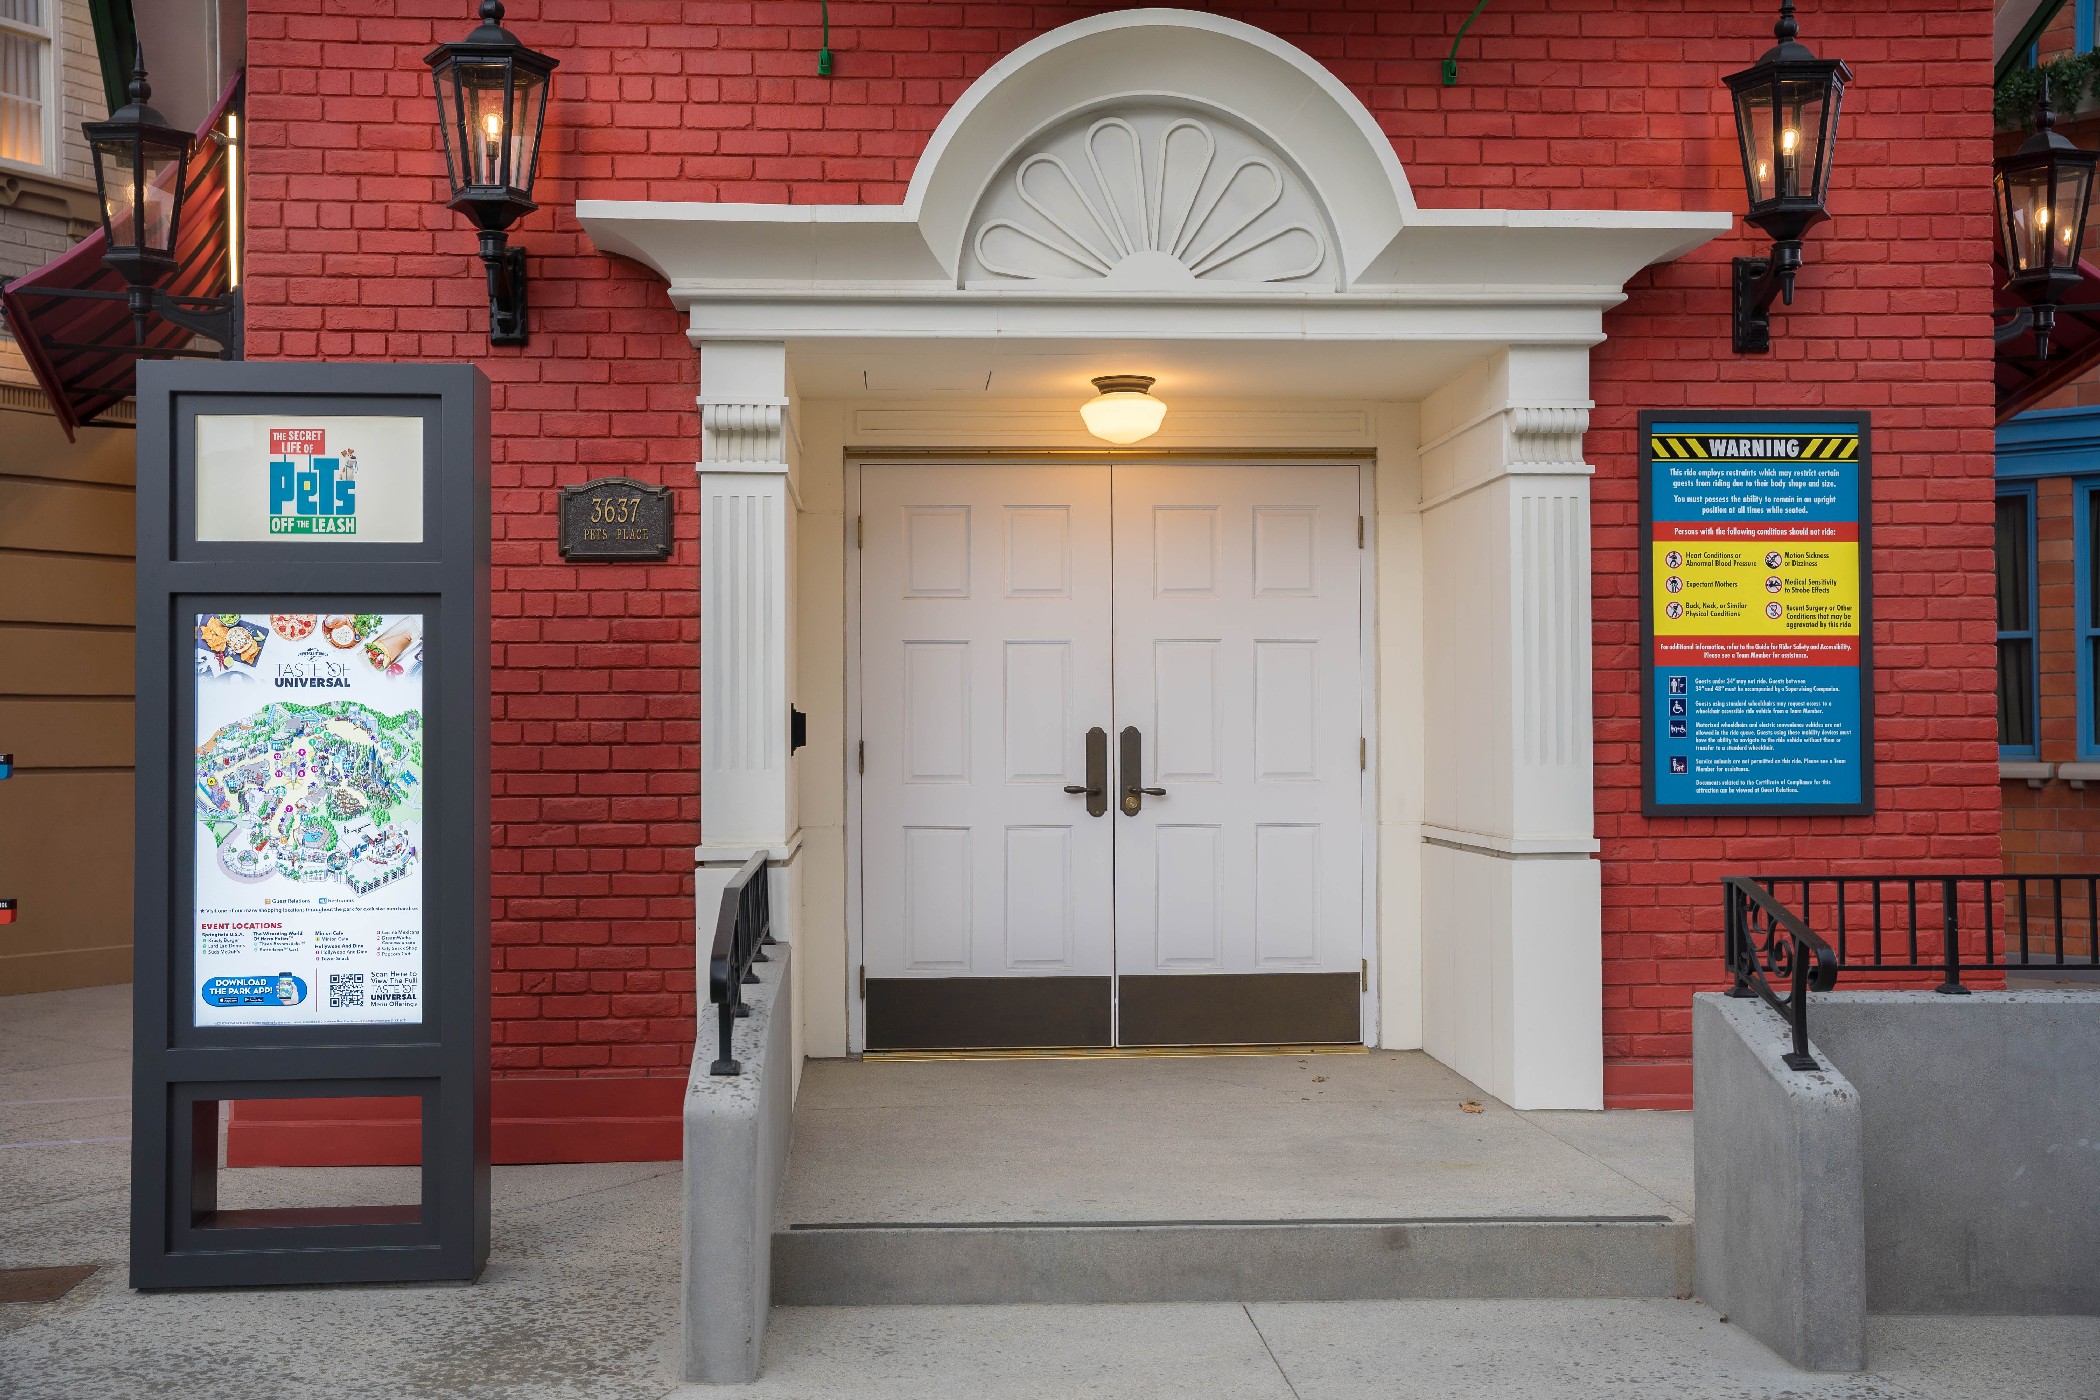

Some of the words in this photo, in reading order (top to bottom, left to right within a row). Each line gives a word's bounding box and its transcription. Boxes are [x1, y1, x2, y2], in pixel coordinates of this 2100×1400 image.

[273, 432, 286, 440] THE
[289, 431, 322, 440] SECRET
[282, 442, 301, 453] LIFE
[304, 444, 313, 453] OF
[1709, 439, 1800, 458] WARNING
[1670, 468, 1682, 477] This
[1684, 468, 1696, 477] ride
[1698, 468, 1724, 477] employs
[1726, 468, 1756, 477] restraints
[1759, 468, 1776, 477] which
[1779, 468, 1791, 477] may
[1794, 468, 1816, 477] restrict
[1818, 468, 1839, 477] certain
[1673, 479, 1693, 488] guests
[1696, 479, 1710, 488] from
[1713, 479, 1730, 488] riding
[1733, 479, 1743, 488] due
[1746, 479, 1752, 488] to
[1754, 479, 1768, 488] their
[1771, 479, 1786, 488] body
[1788, 479, 1806, 488] shape
[1809, 479, 1819, 488] and
[1822, 479, 1836, 488] size.
[1674, 495, 1685, 504] You
[1687, 495, 1702, 504] must
[1705, 495, 1729, 504] possess
[1731, 495, 1741, 504] the
[1743, 495, 1762, 504] ability
[1765, 495, 1771, 504] to
[1774, 495, 1795, 504] remain
[1797, 495, 1802, 504] in
[1804, 495, 1811, 504] an
[1814, 495, 1836, 504] upright
[591, 498, 640, 523] 3637
[1702, 506, 1727, 515] position
[1729, 506, 1735, 515] at
[1747, 506, 1764, 515] times
[1766, 506, 1783, 515] while
[1785, 506, 1808, 515] seated.
[272, 518, 294, 532] OFF
[297, 520, 309, 528] THE
[312, 518, 354, 532] LEASH
[584, 529, 608, 540] PETS
[616, 529, 649, 540] PLACE
[1675, 528, 1698, 537] Persons
[1700, 528, 1713, 537] with
[1716, 528, 1725, 537] the
[1727, 528, 1755, 537] following
[1757, 528, 1787, 537] conditions
[1790, 528, 1808, 537] should
[1810, 528, 1820, 537] not
[1822, 528, 1836, 537] ride:
[1786, 621, 1818, 629] aggravated
[1820, 621, 1826, 629] by
[1828, 621, 1838, 629] this
[1840, 621, 1851, 629] ride
[1669, 643, 1693, 651] additional
[1695, 643, 1725, 651] information,
[1727, 643, 1738, 651] refer
[1740, 643, 1745, 651] to
[1746, 643, 1754, 651] the
[1755, 643, 1769, 651] Guide
[1779, 643, 1792, 651] Rider
[1793, 643, 1809, 651] Safety
[1810, 643, 1819, 651] and
[1820, 643, 1851, 651] Accessibility.
[275, 678, 350, 687] UNIVERSAL
[216, 979, 266, 987] DOWNLOAD
